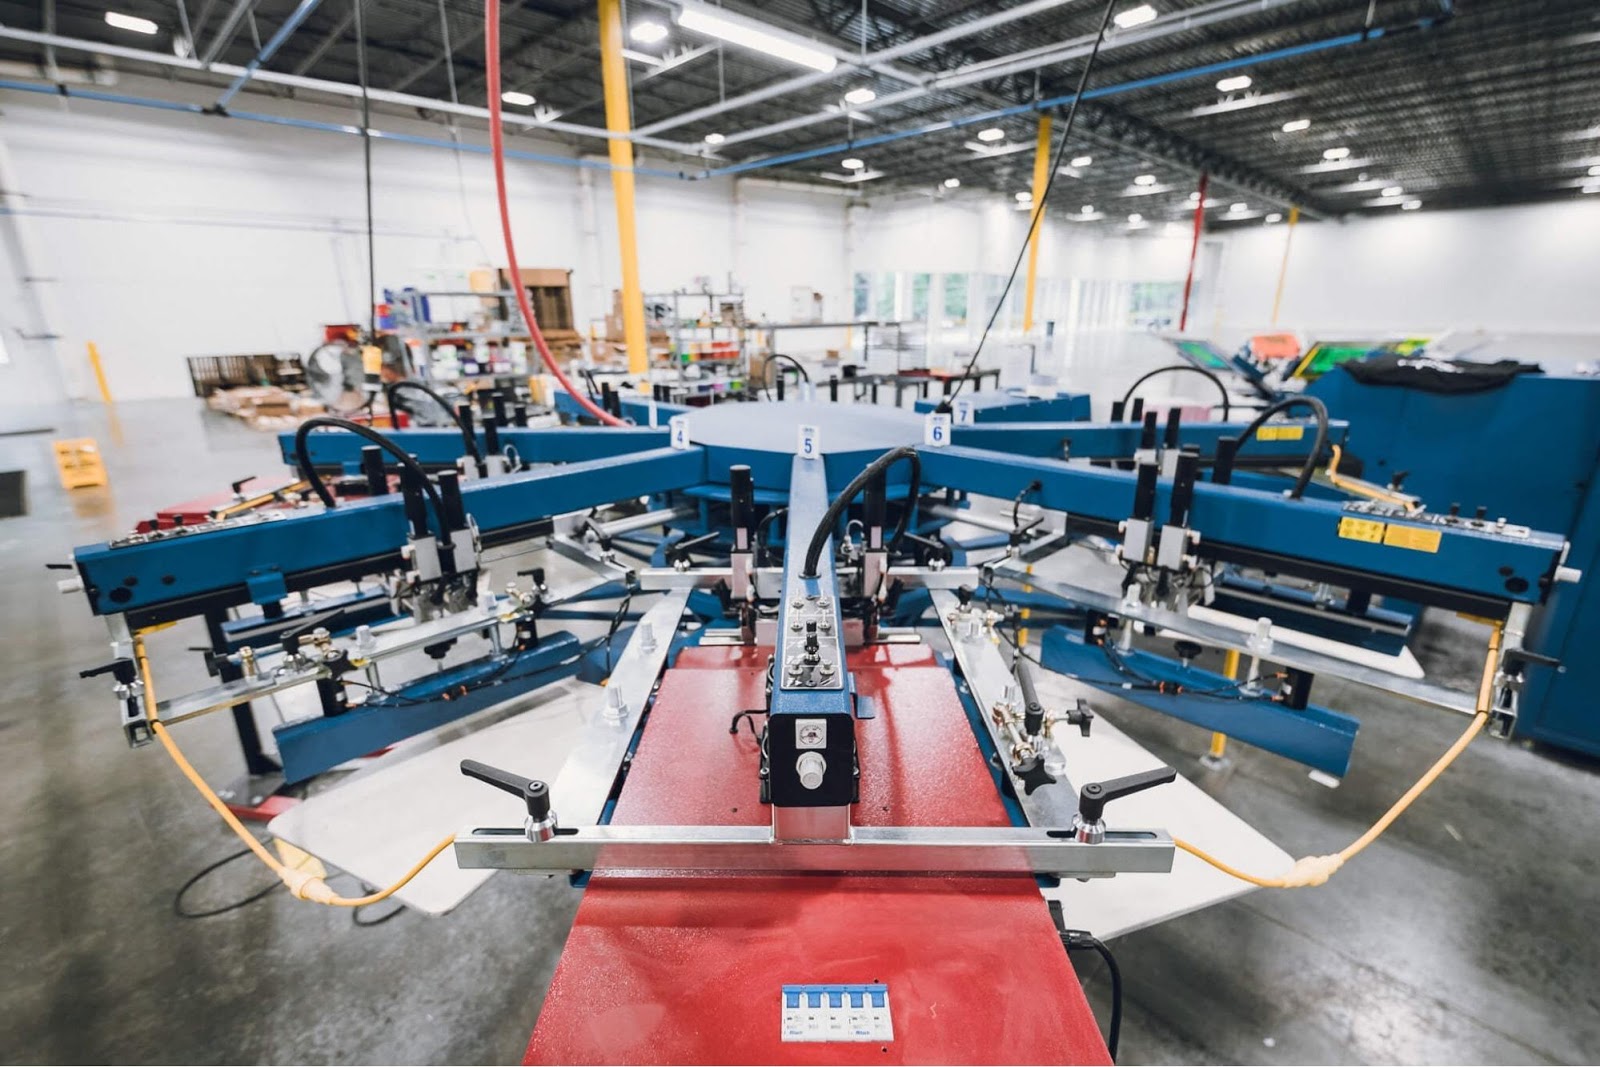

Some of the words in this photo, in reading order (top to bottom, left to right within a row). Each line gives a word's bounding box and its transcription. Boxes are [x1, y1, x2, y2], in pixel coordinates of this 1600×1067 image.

[959, 410, 967, 422] 7
[676, 429, 684, 443] 4
[933, 426, 943, 441] 6
[804, 437, 812, 454] 5
